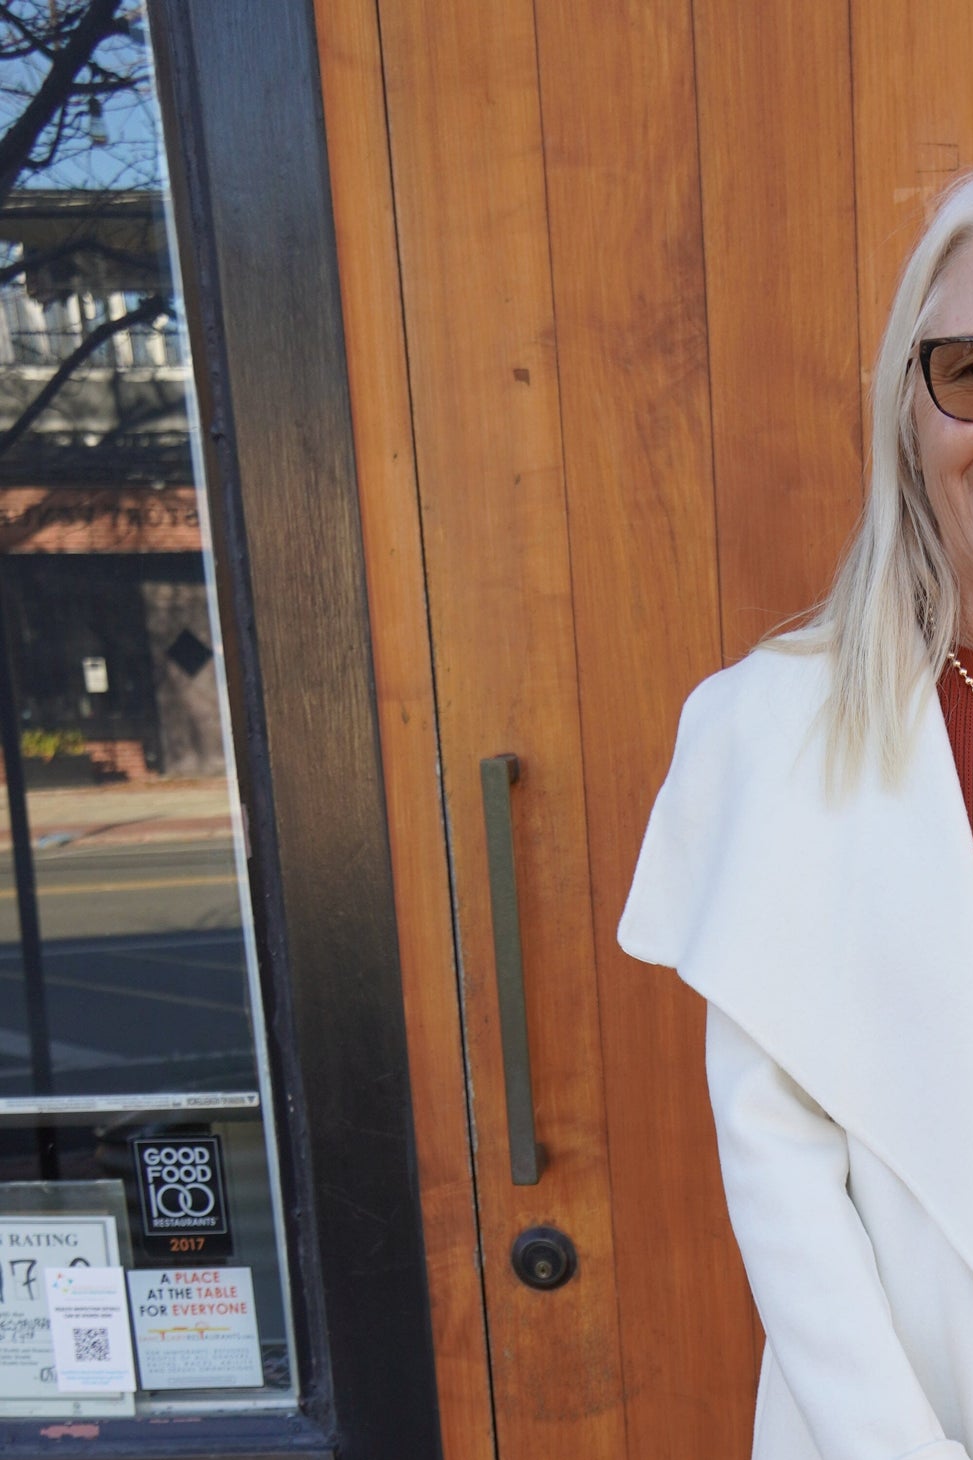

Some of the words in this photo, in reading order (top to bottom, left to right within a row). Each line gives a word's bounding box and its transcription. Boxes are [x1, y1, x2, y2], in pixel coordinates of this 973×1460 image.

[144, 1147, 210, 1165] GOOD
[146, 1165, 212, 1183] FOOD
[149, 1183, 215, 1218] 100
[153, 1217, 216, 1228] RESTAURANTS
[9, 1233, 79, 1247] RATING
[170, 1238, 206, 1252] 2017
[160, 1272, 171, 1285] A
[174, 1271, 221, 1284] PLACE
[147, 1288, 163, 1301] AT
[168, 1287, 192, 1300] THE
[196, 1286, 238, 1299] TABLE
[139, 1304, 168, 1317] FOR
[172, 1302, 248, 1316] EVERYONE
